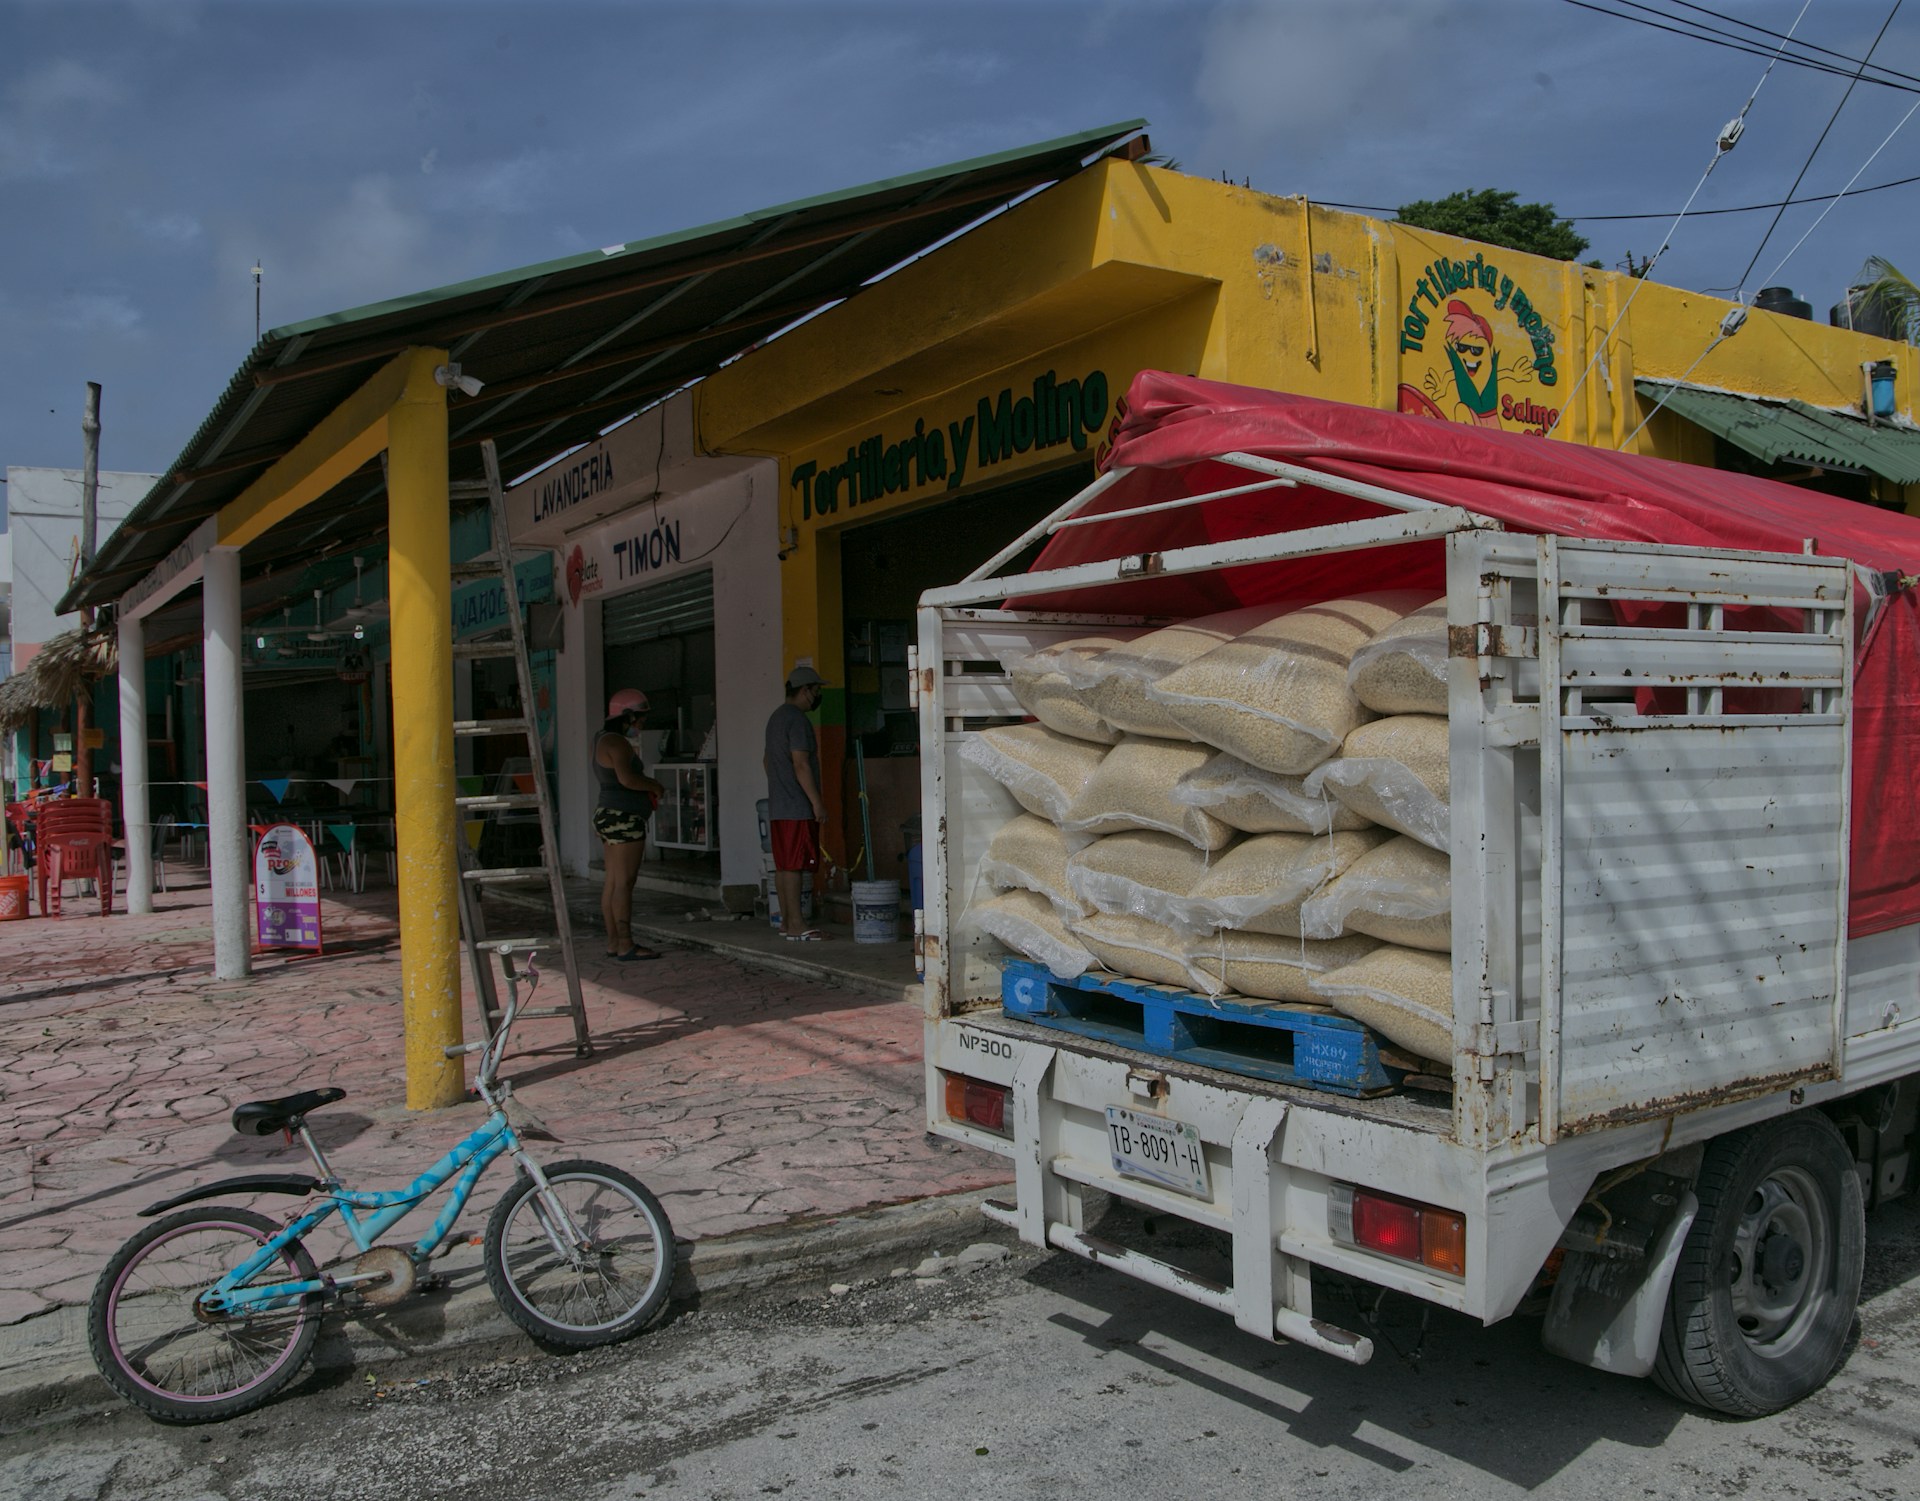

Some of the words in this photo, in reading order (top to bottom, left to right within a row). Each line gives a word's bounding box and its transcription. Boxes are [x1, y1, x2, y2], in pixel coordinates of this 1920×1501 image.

[1400, 253, 1498, 355] Tortilleria
[1493, 273, 1514, 311] y
[792, 417, 948, 520] Tortilleria
[948, 415, 975, 491] y
[977, 369, 1109, 468] Molino
[613, 516, 682, 580] TIMÓN
[459, 578, 525, 629] JAROCO
[285, 887, 317, 897] MILLONES
[959, 1032, 1013, 1060] NP300
[1109, 1124, 1202, 1176] TB-8091-H
